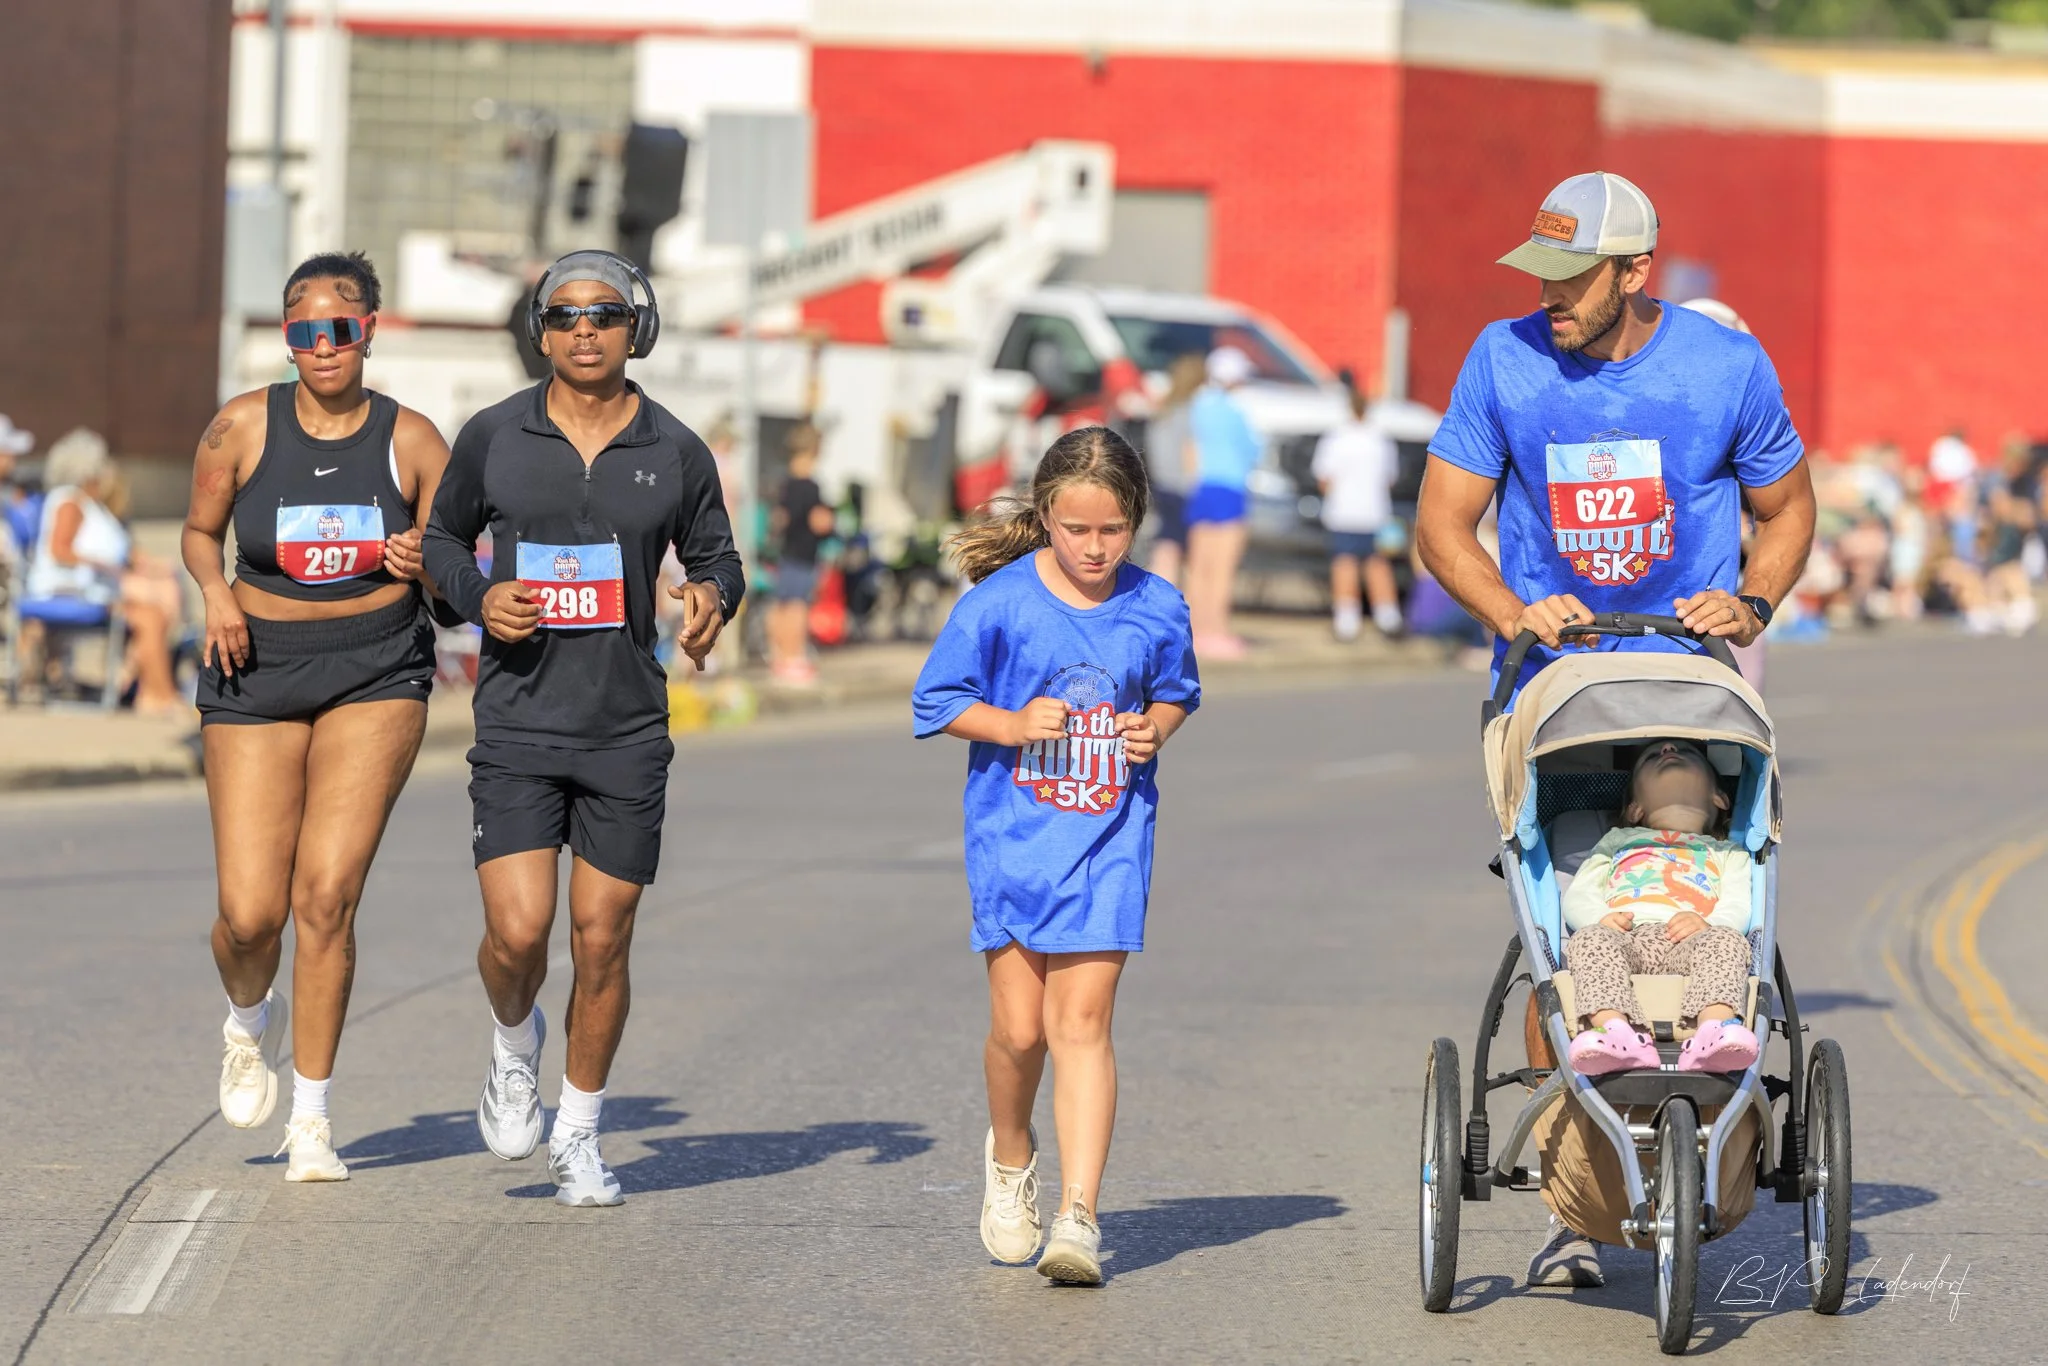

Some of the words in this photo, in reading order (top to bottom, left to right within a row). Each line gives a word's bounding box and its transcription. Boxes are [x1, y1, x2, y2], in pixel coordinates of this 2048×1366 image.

[1589, 460, 1616, 474] ROUTE
[1575, 486, 1638, 523] 622
[304, 546, 359, 577] 297
[1591, 552, 1637, 581] 5K
[540, 586, 599, 619] 298
[1090, 707, 1118, 736] th
[1055, 781, 1102, 811] 5K
